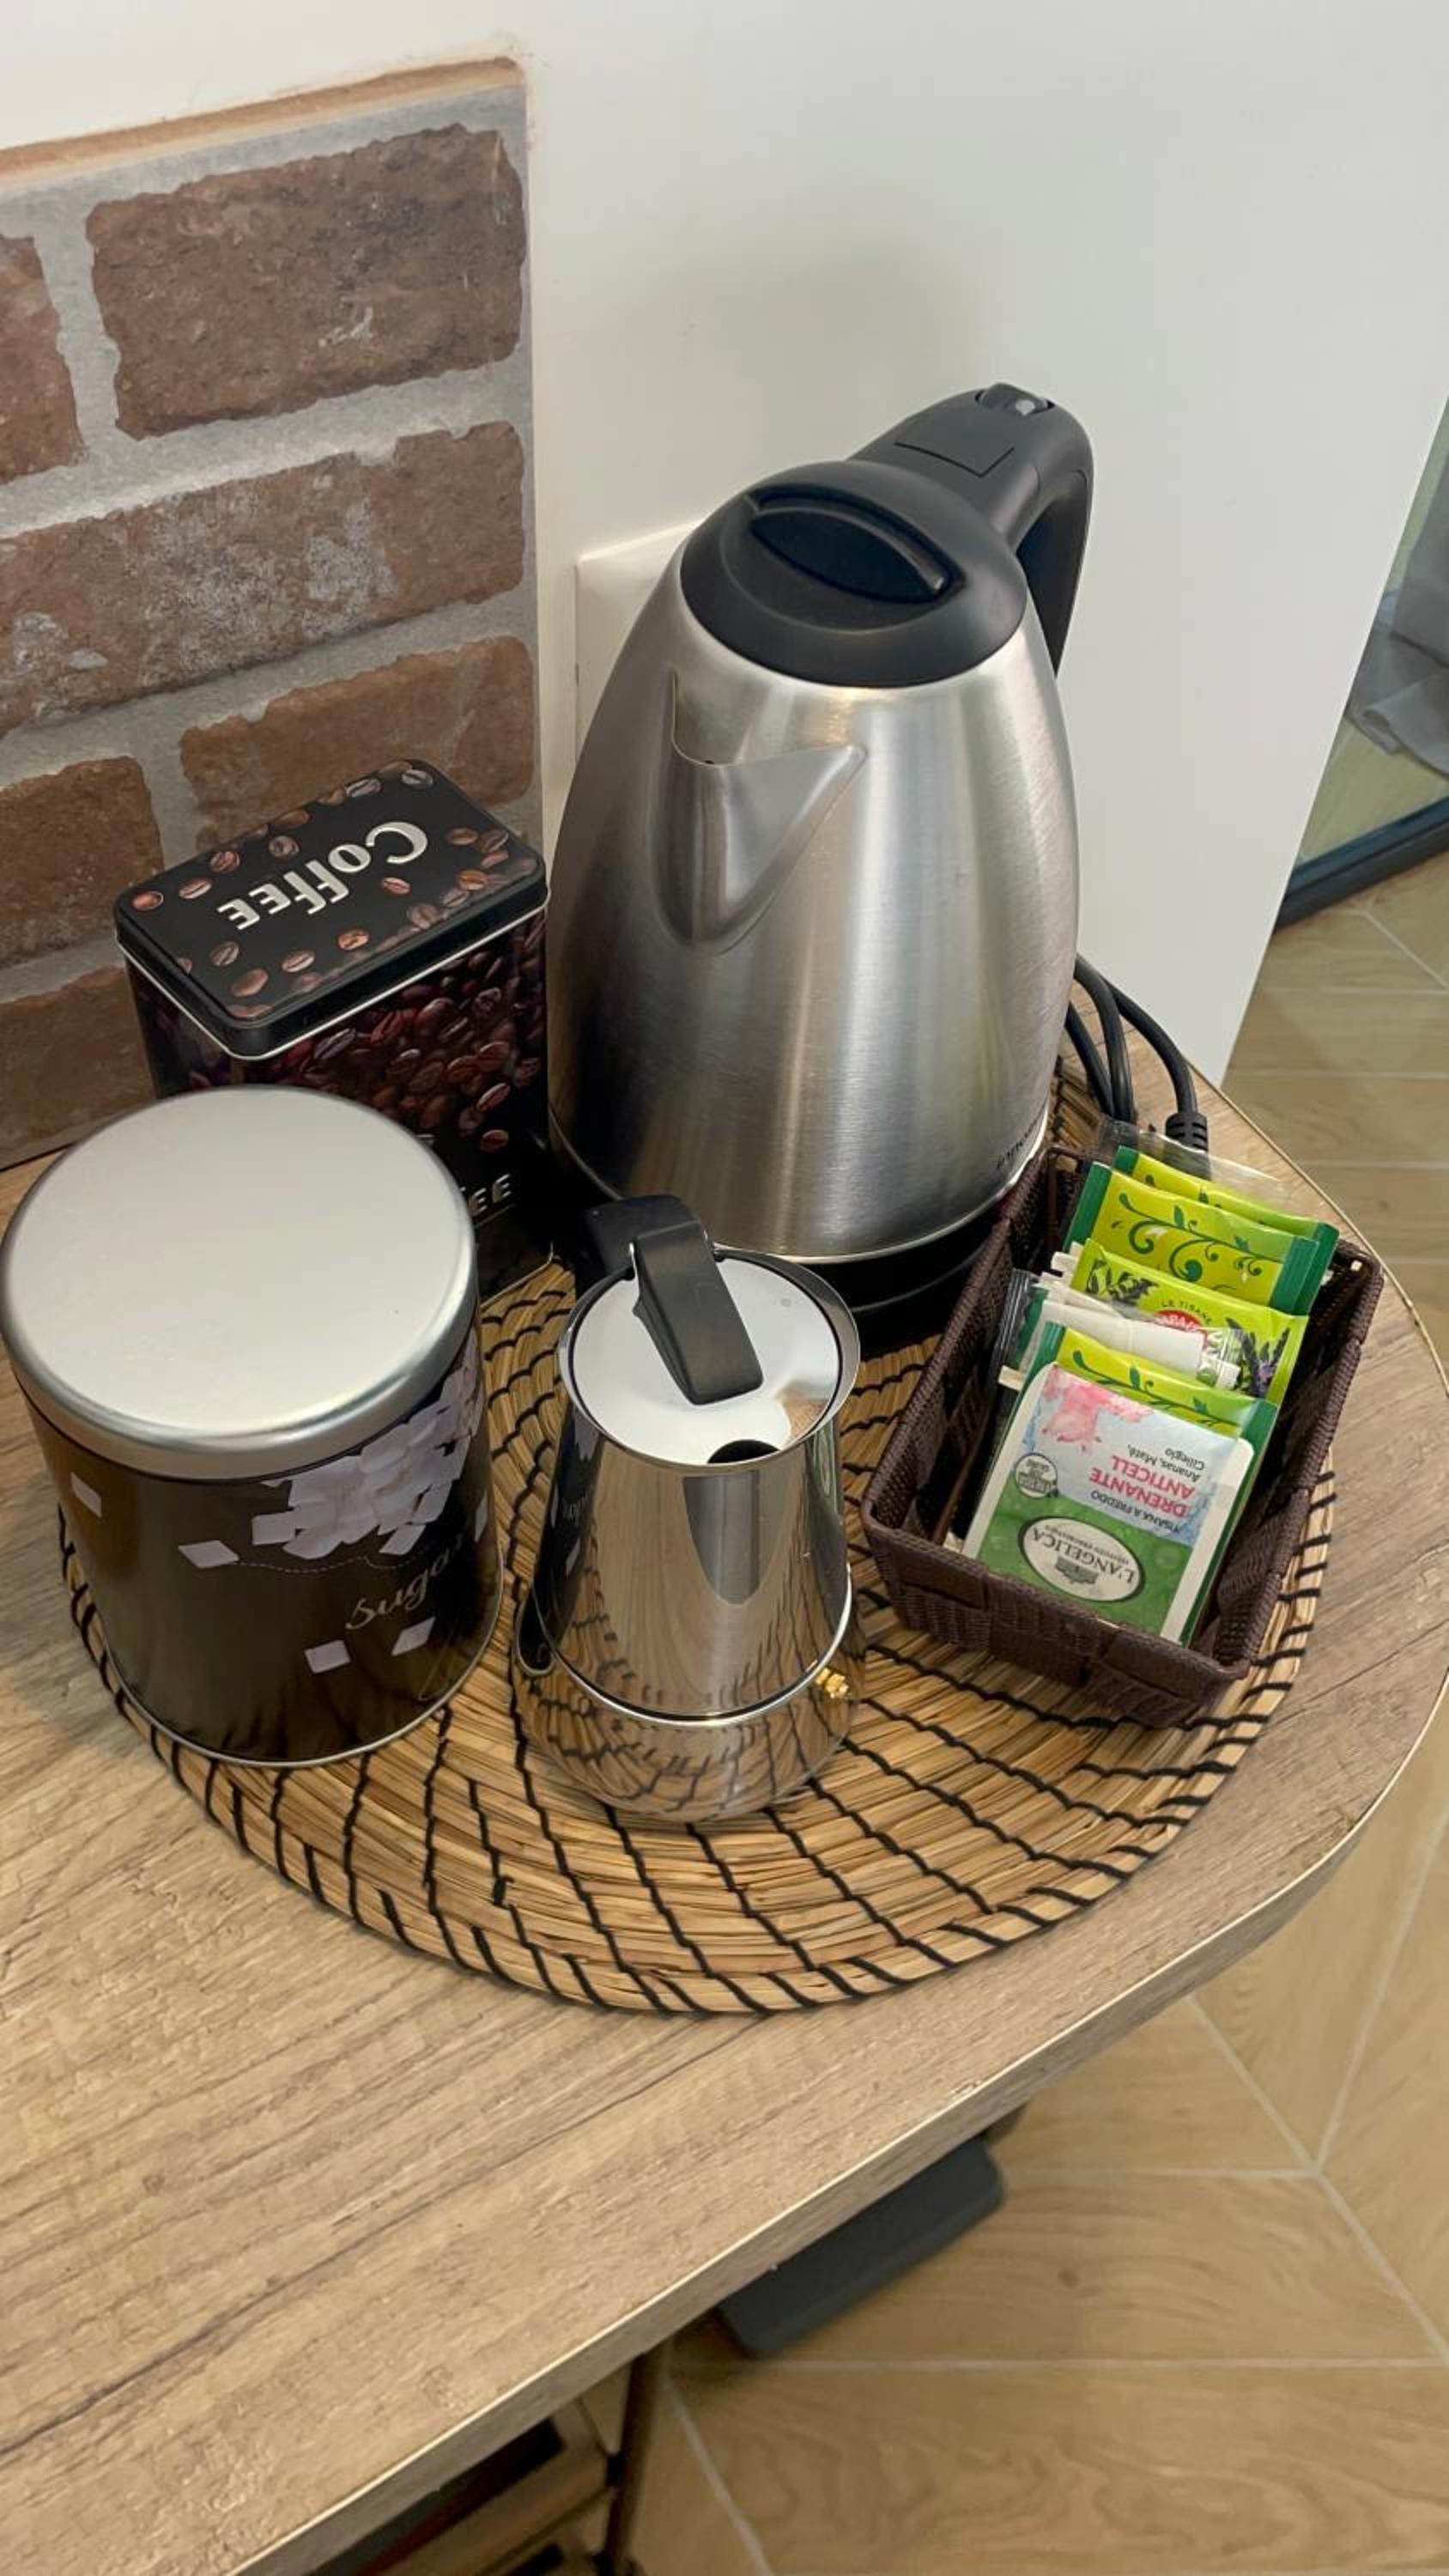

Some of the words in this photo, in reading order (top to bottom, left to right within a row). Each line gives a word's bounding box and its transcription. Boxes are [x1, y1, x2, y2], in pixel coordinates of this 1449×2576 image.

[1111, 1455, 1196, 1499] ANTICELL
[1157, 1457, 1201, 1483] Ananas,
[1088, 1467, 1190, 1518] DRENANTE
[1091, 1490, 1132, 1514] FREDDO
[1033, 1528, 1136, 1583] L'ANGELICA
